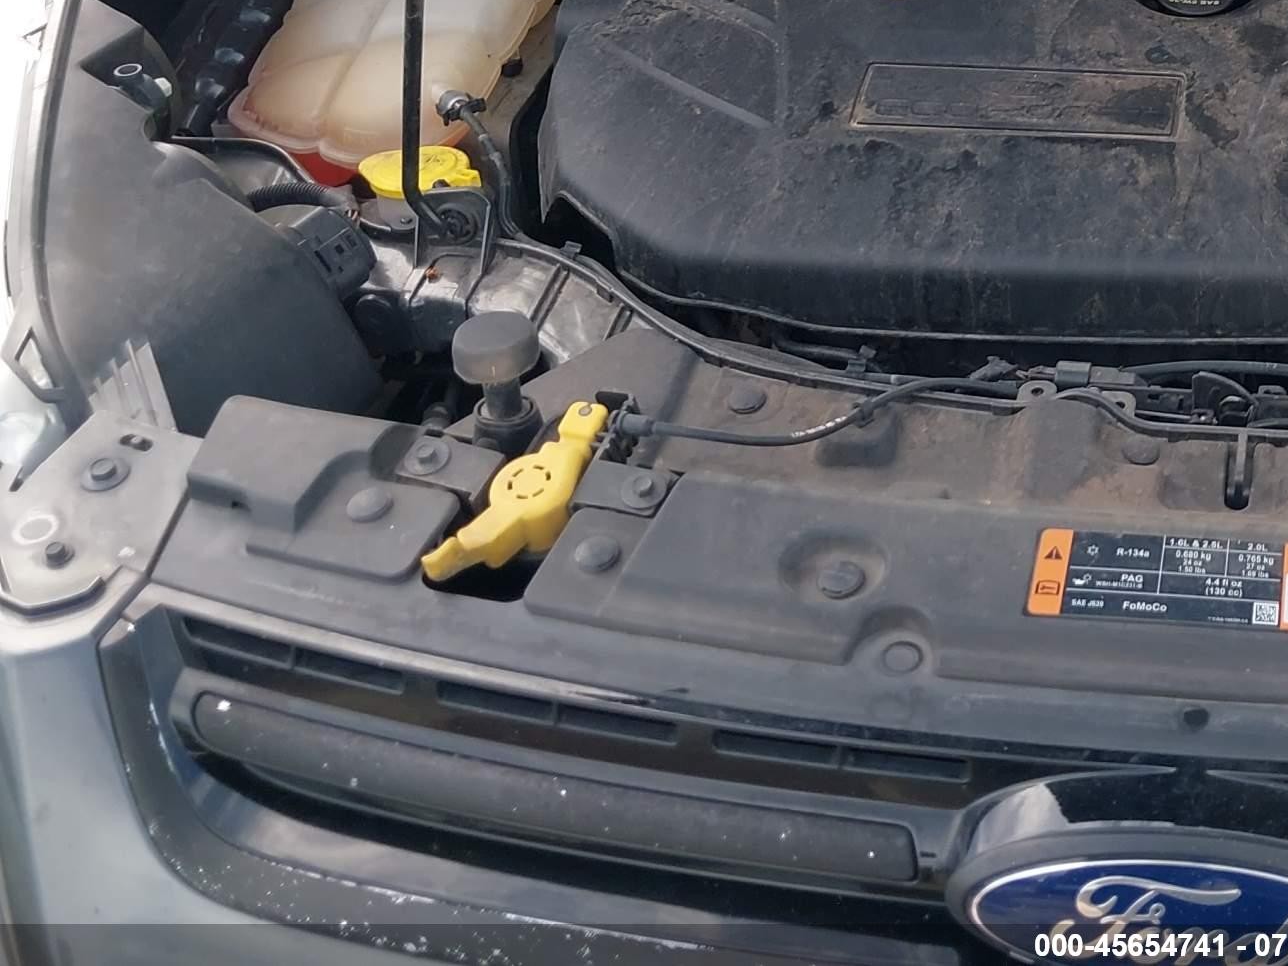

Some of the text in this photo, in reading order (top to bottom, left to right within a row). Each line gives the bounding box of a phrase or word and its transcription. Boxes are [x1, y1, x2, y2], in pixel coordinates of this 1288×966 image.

[1169, 538, 1190, 547] 1.6L
[1192, 539, 1200, 548] &
[1247, 542, 1268, 552] 2.0L
[1116, 547, 1150, 558] R-134a
[1175, 549, 1212, 562] 0.680 kg
[1263, 554, 1275, 566] kg
[1120, 573, 1144, 583] PAG
[1205, 577, 1243, 588] 4.4 fl oz
[1205, 586, 1243, 598] (130 cc)
[1071, 598, 1087, 606] SAE
[1122, 600, 1168, 612] FoMoCo
